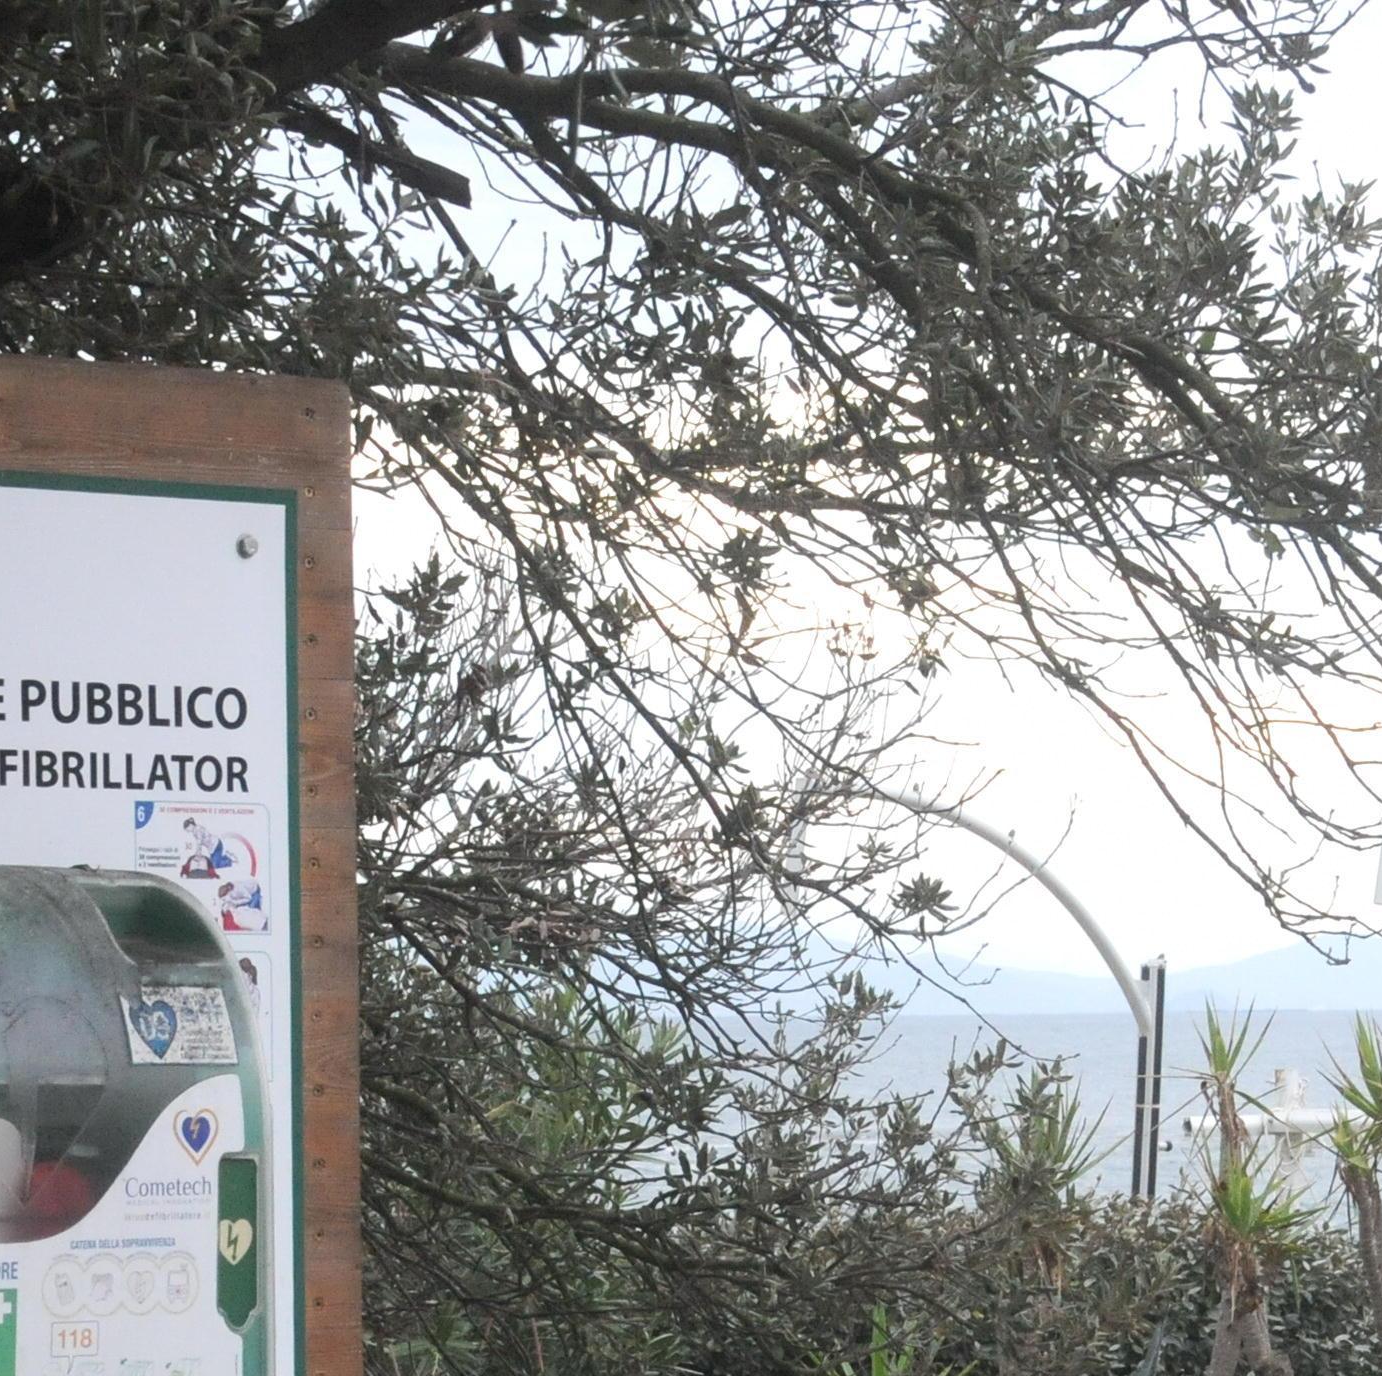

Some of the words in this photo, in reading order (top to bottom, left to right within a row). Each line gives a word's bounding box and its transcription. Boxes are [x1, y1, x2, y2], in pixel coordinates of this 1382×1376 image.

[21, 679, 248, 730] PUBBLICO
[137, 805, 145, 822] 6
[125, 1176, 211, 1198] Cometech
[58, 1328, 93, 1349] 118
